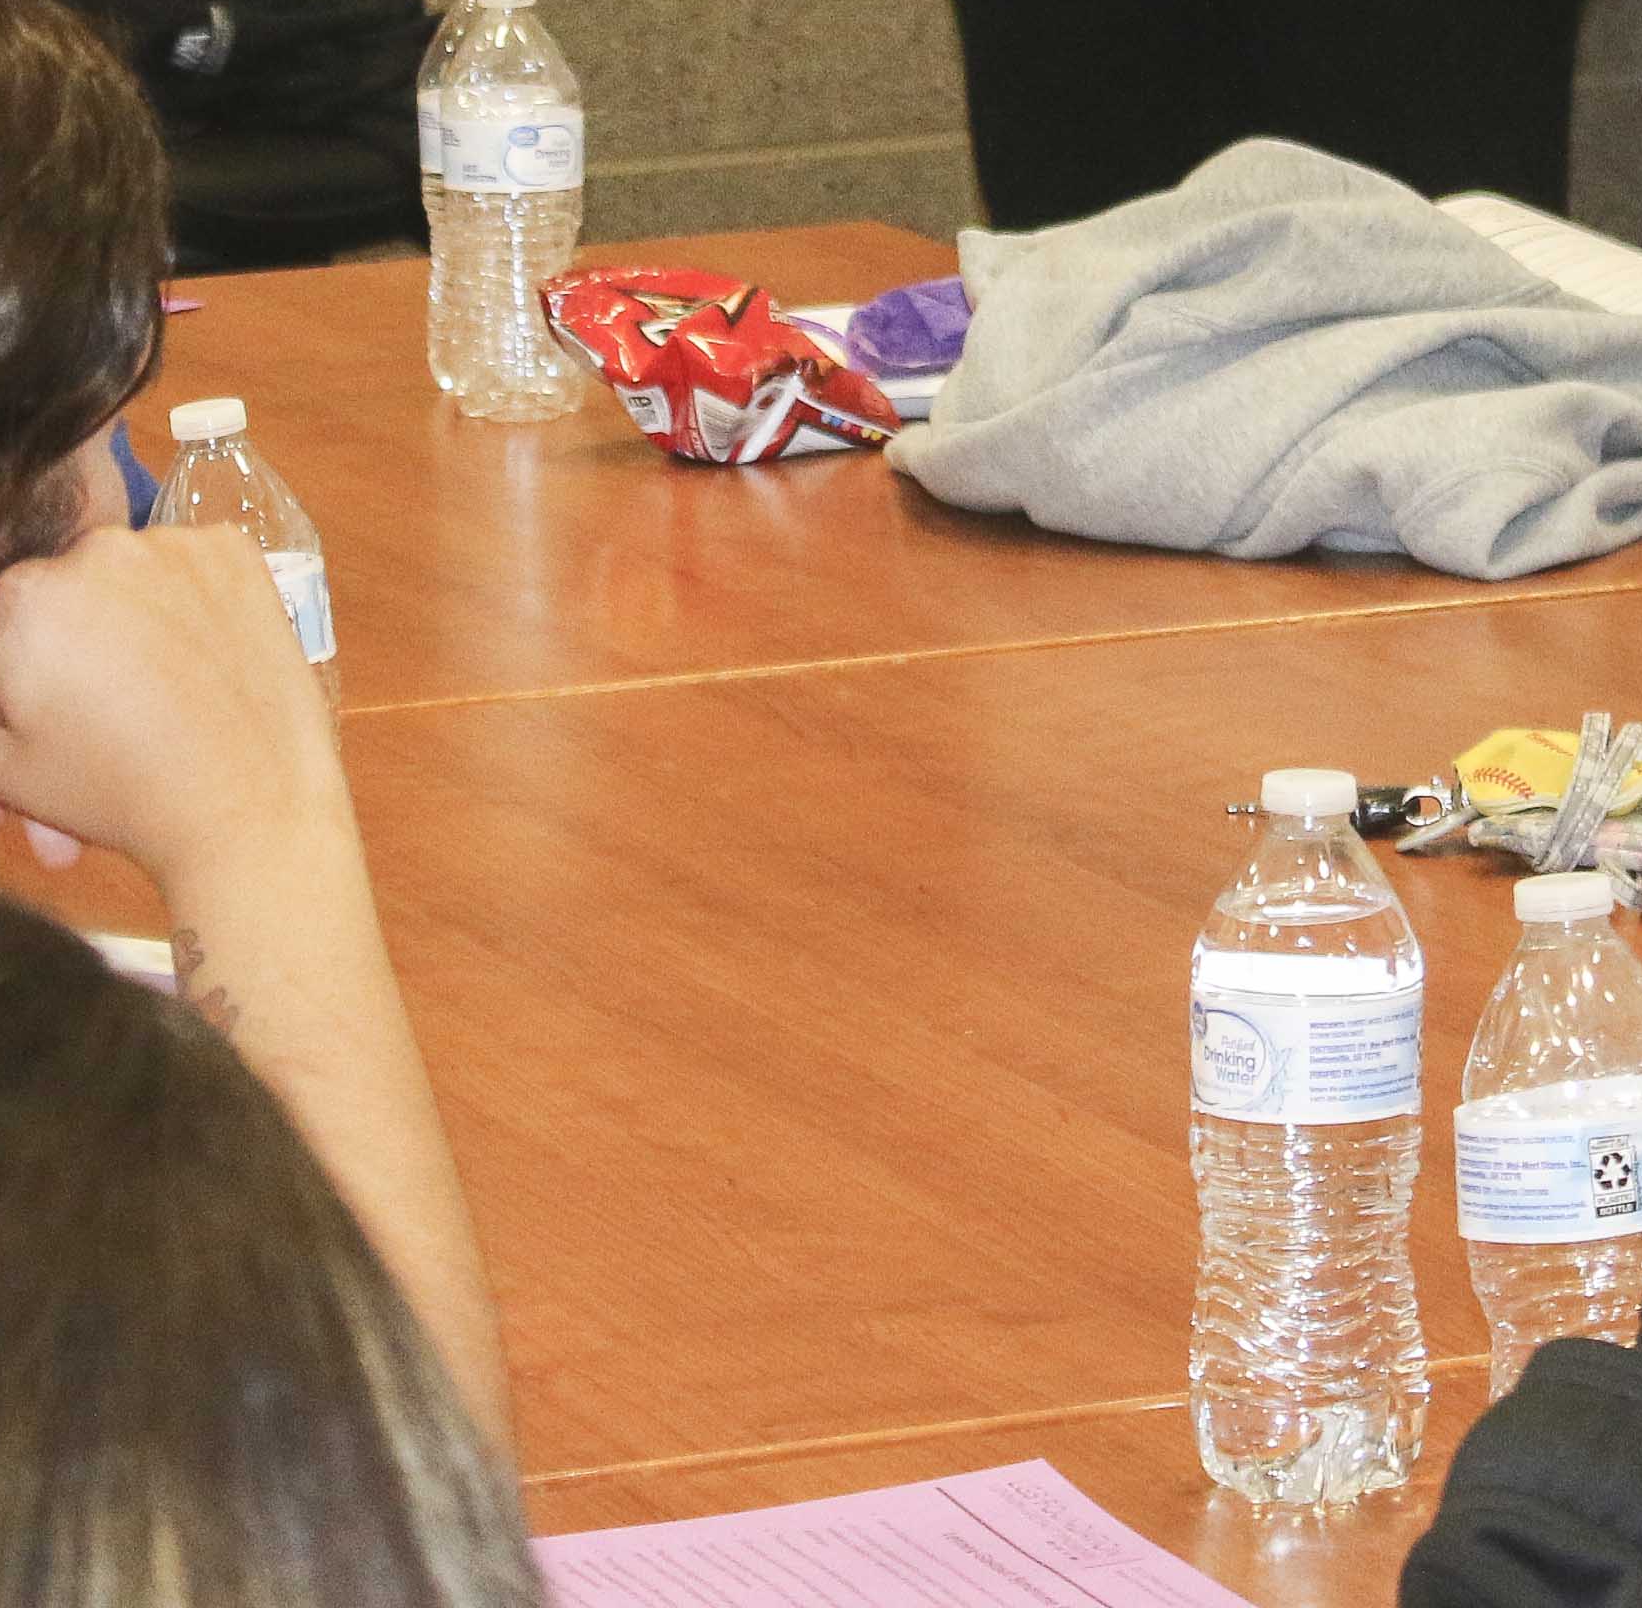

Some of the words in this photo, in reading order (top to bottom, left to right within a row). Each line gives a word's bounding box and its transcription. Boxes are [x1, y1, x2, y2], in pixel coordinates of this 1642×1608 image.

[1203, 1044, 1256, 1074] Drinking
[1214, 1064, 1258, 1086] Water
[1598, 1203, 1636, 1217] BOTTLE
